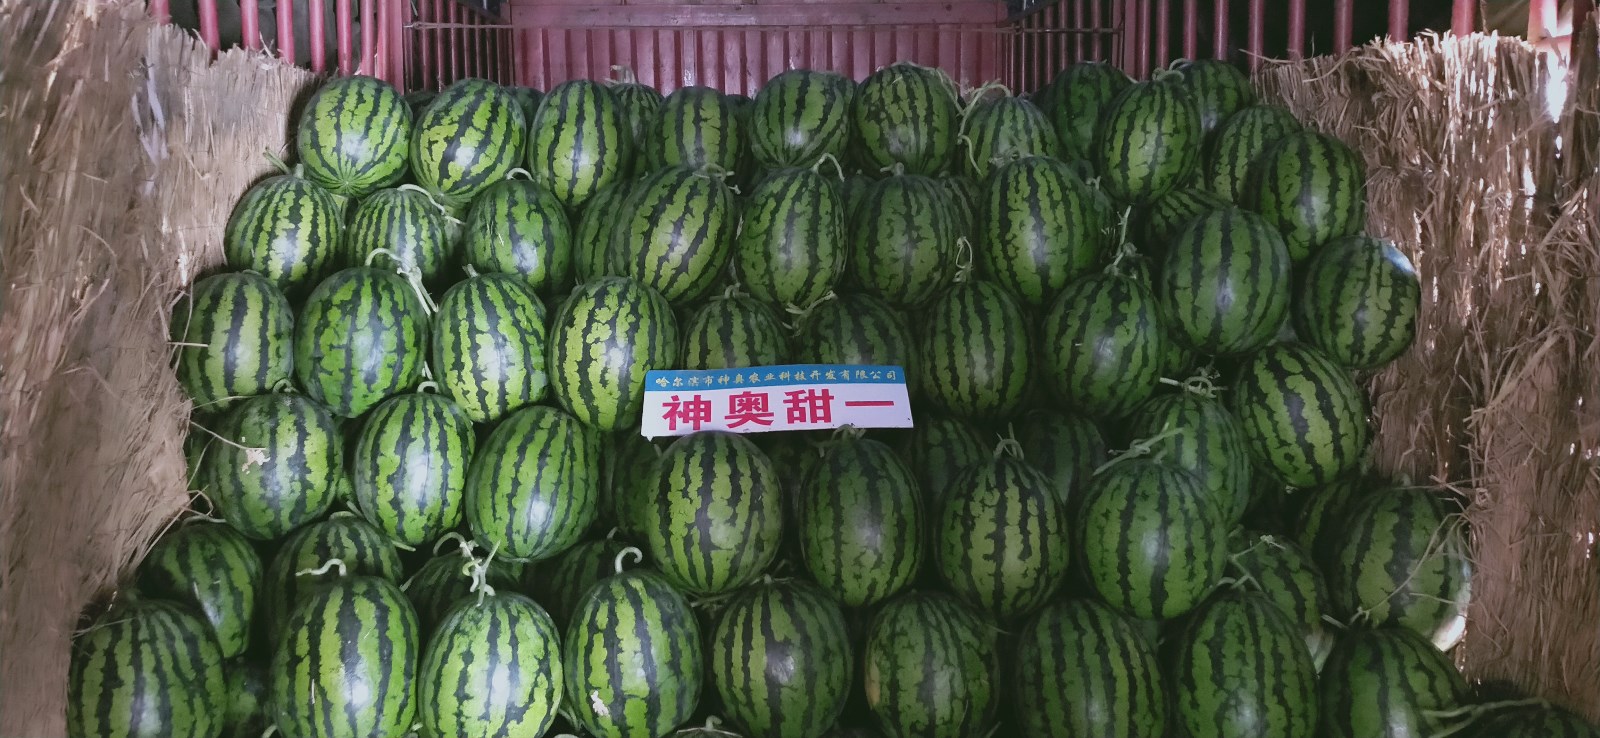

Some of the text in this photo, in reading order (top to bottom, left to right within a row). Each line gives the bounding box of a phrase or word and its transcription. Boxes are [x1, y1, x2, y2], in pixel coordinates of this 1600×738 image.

[655, 369, 897, 387] 哈尔滨市神奥农业科技开发有限公司
[661, 388, 895, 431] 神奥甜一
